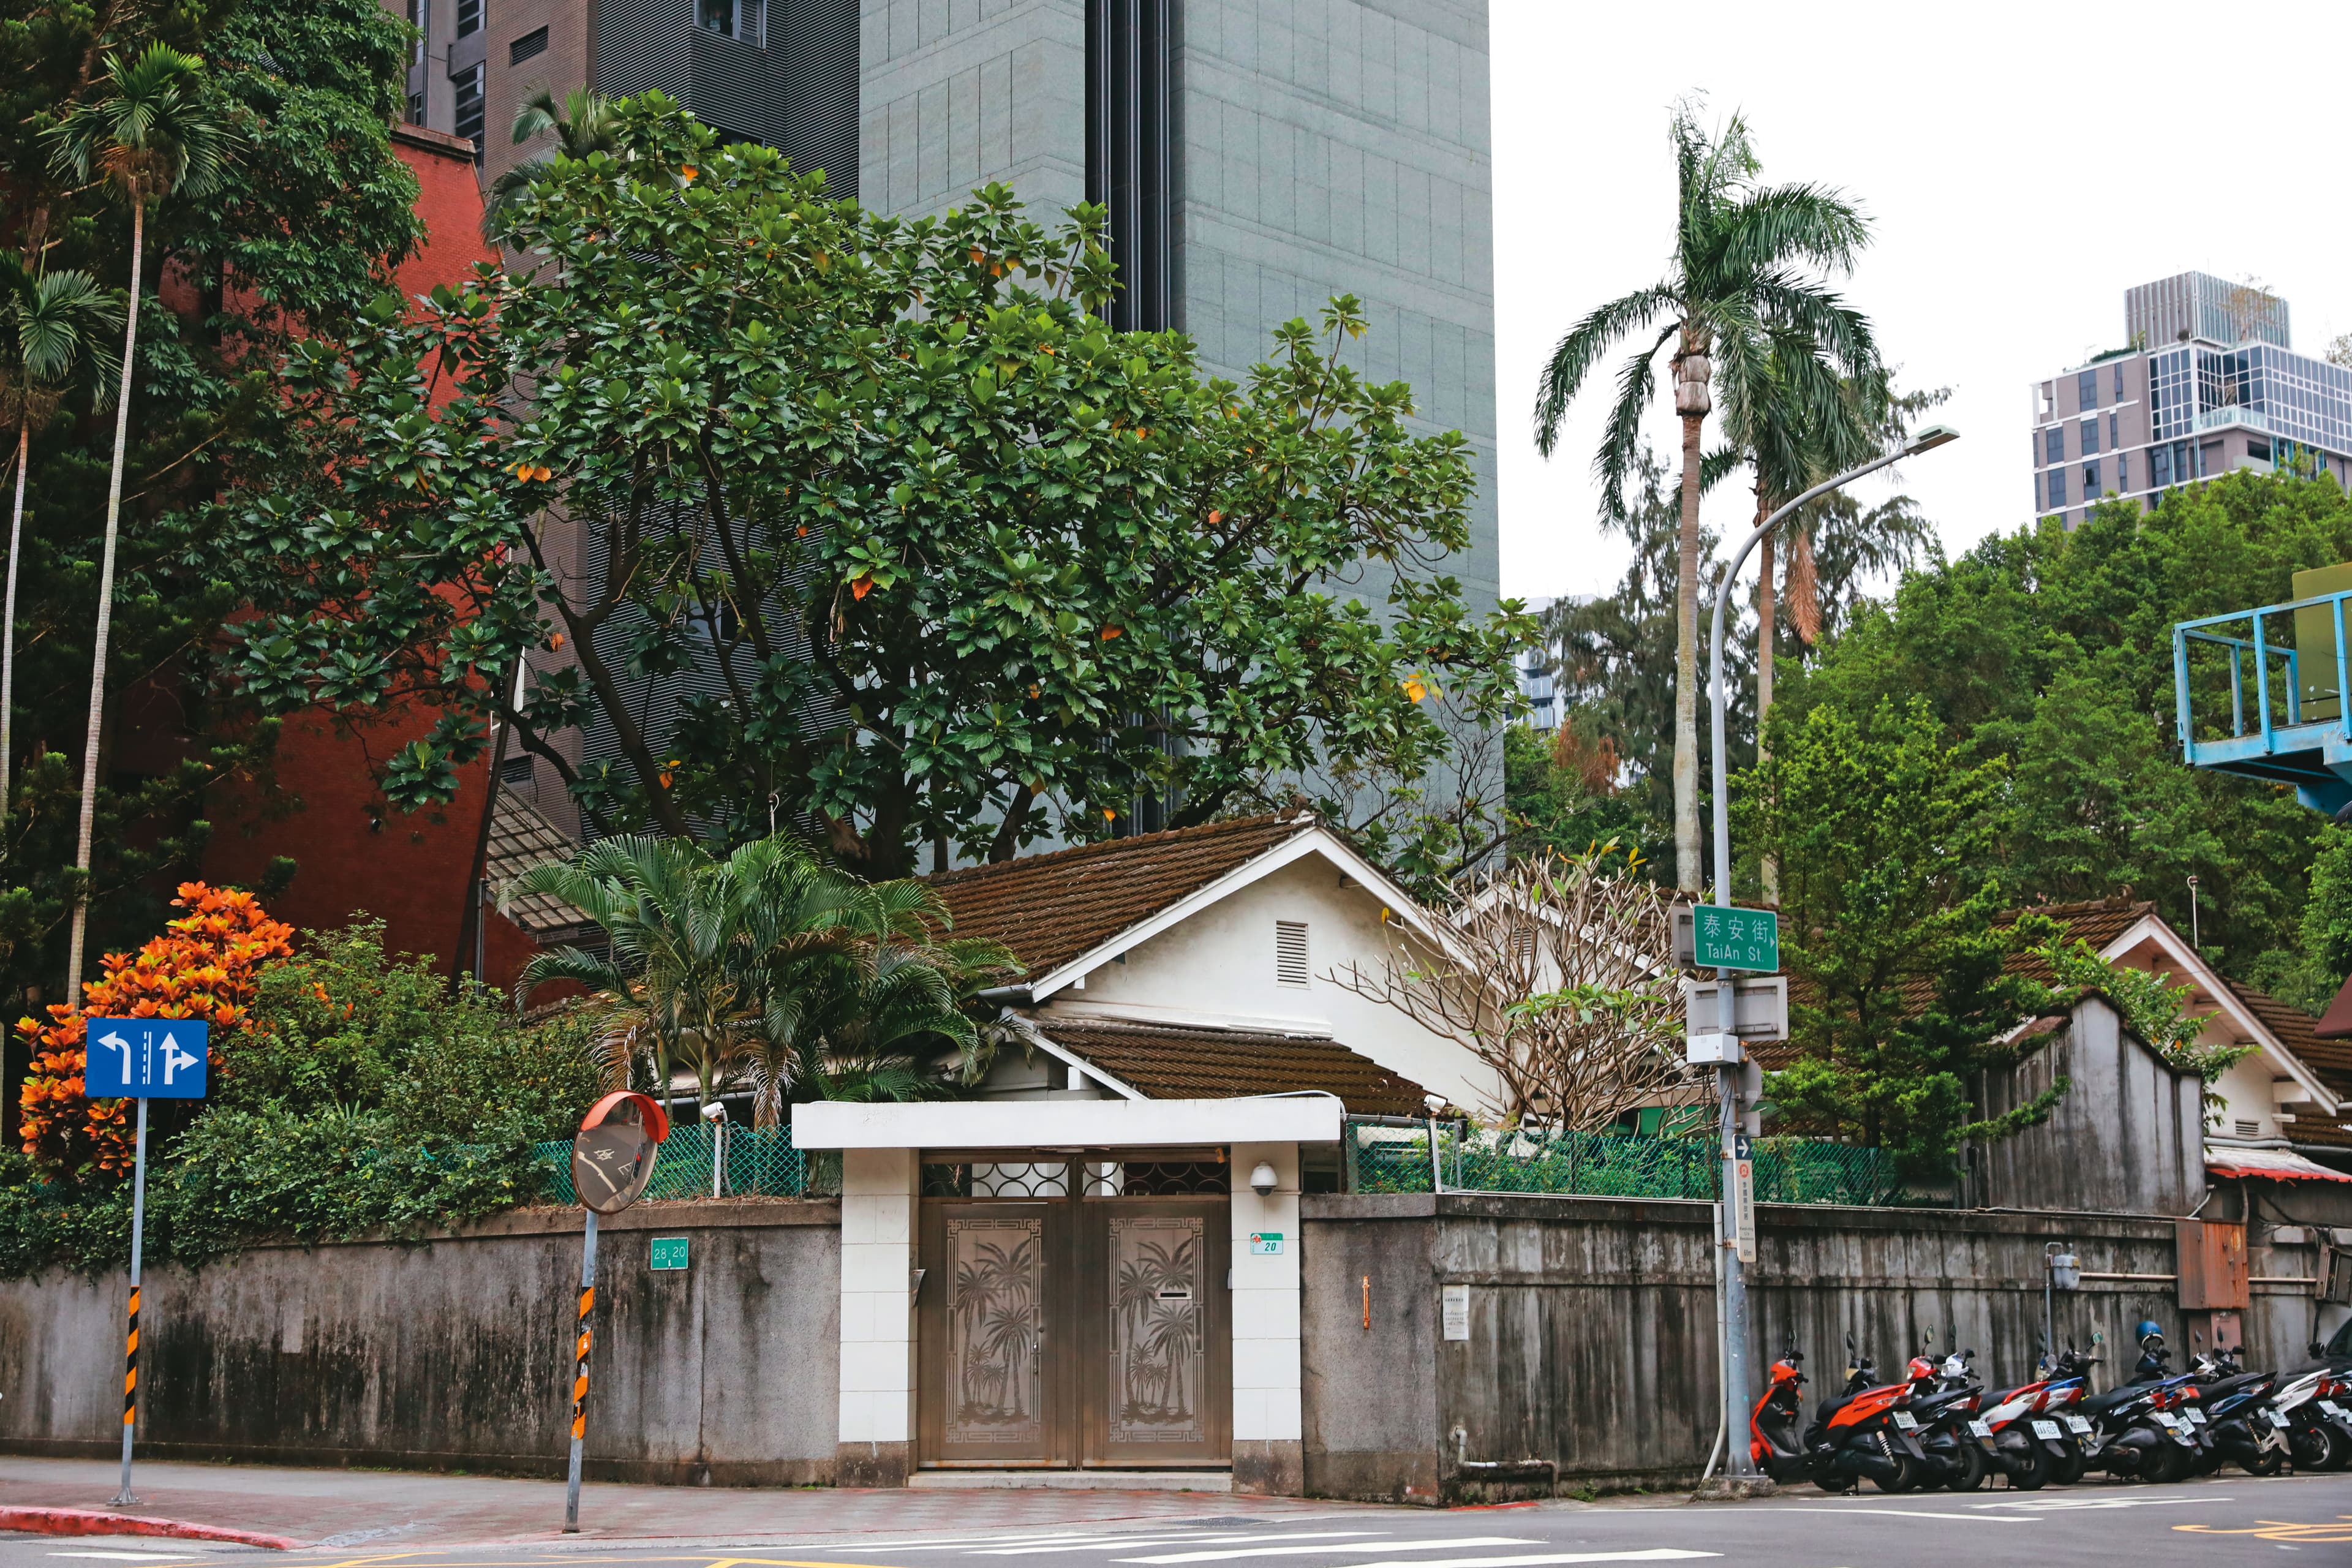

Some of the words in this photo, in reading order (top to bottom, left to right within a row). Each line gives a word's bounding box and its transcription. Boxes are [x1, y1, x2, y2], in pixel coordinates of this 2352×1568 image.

[1704, 913, 1768, 943] 泰安街
[1706, 943, 1740, 960] TaiAn
[1748, 947, 1763, 962] St.
[654, 1248, 666, 1259] 28
[673, 1246, 685, 1257] 20
[1265, 1242, 1276, 1251] 20
